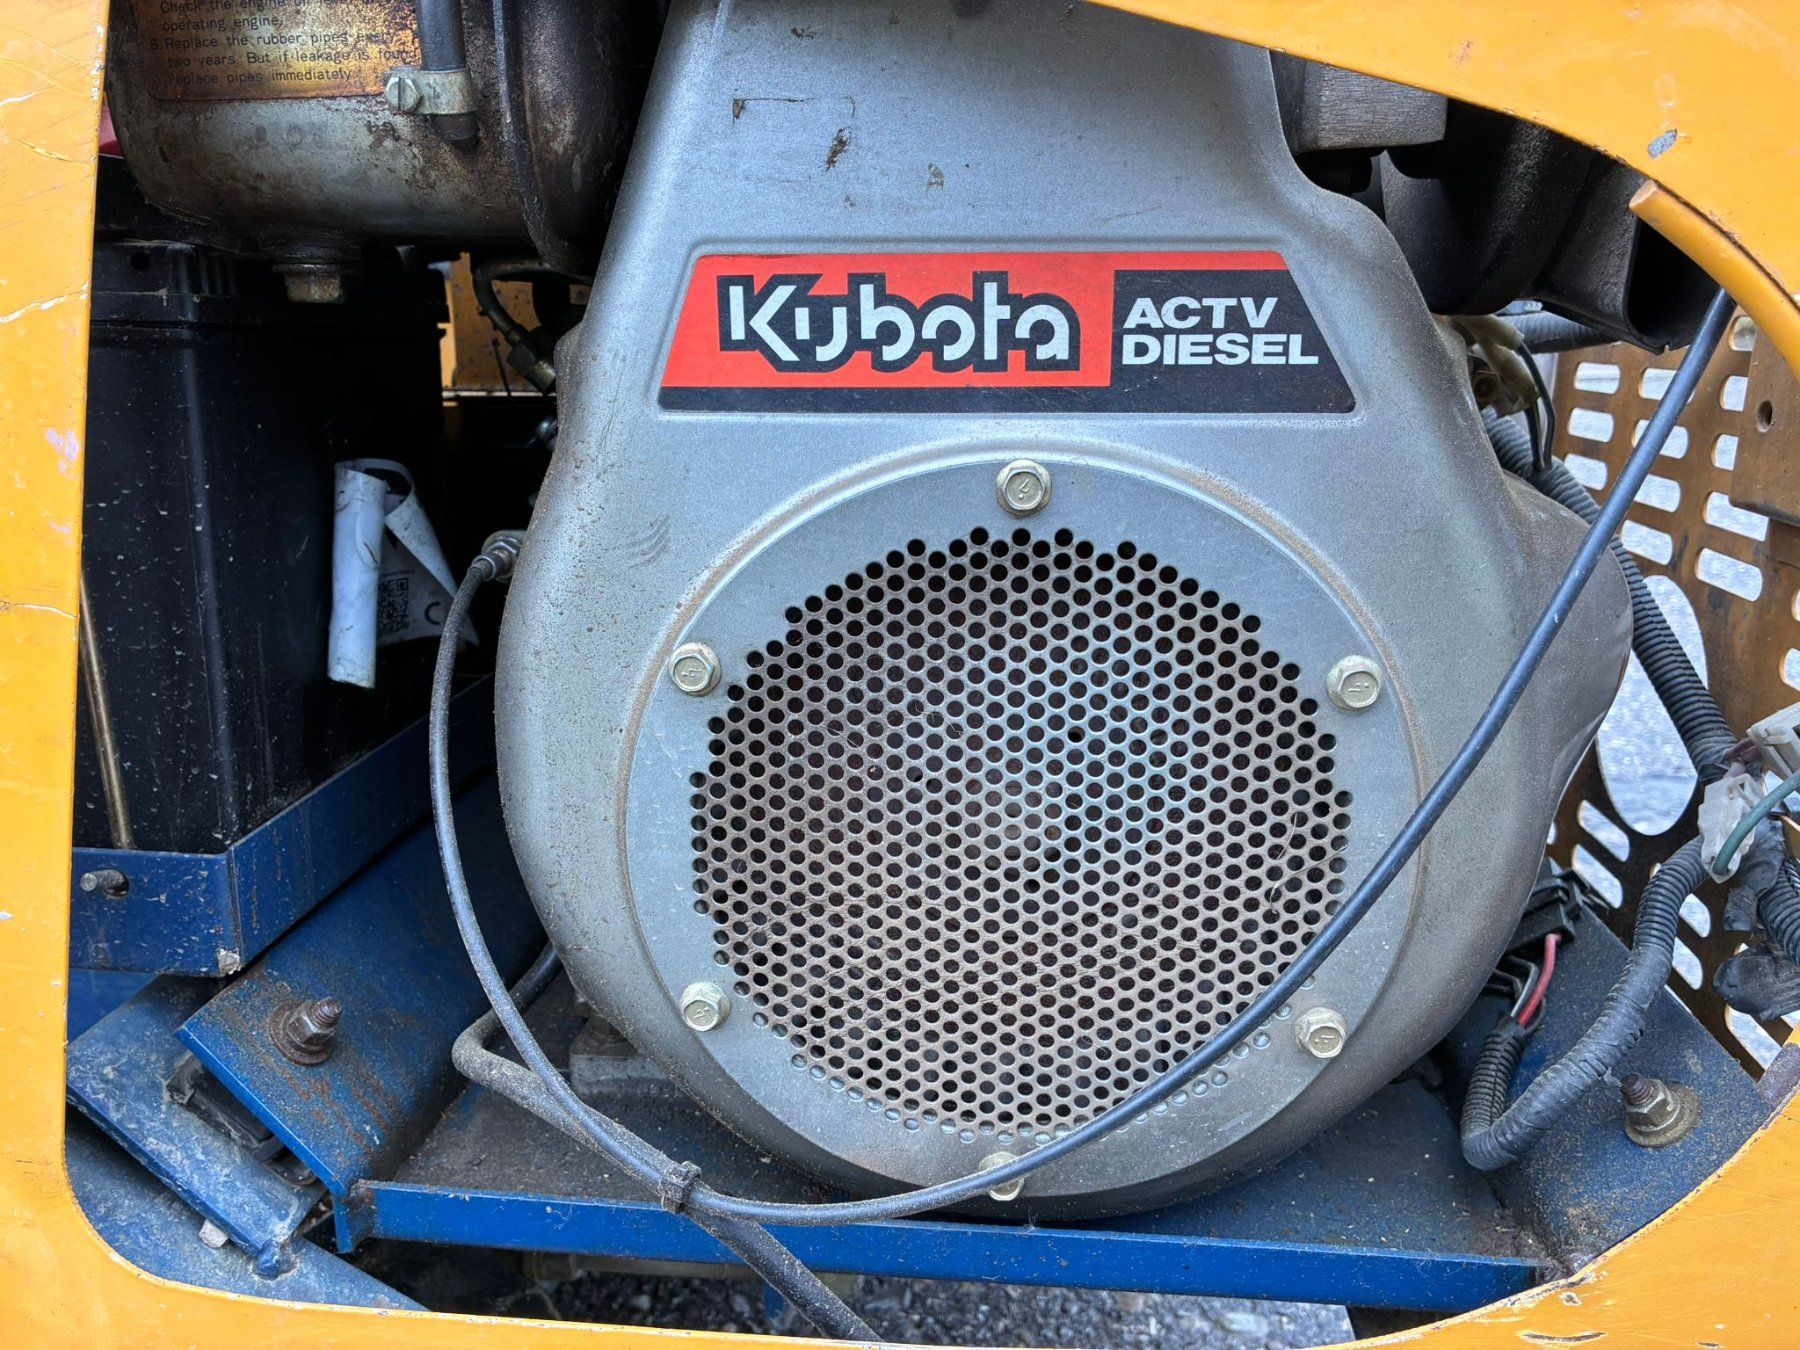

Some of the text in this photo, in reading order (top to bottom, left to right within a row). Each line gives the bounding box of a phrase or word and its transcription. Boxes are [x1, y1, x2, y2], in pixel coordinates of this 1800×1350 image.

[210, 0, 233, 10] the
[162, 19, 227, 32] operating
[164, 36, 219, 50] Replace
[226, 34, 249, 46] the
[256, 33, 302, 46] rubber
[310, 31, 349, 45] pipes
[246, 51, 272, 64] But
[279, 50, 288, 62] if
[296, 47, 350, 64] leakage
[357, 49, 370, 60] is
[227, 71, 263, 83] pipes
[728, 281, 1070, 362] Kubota
[1122, 296, 1278, 329] ACTV
[1121, 332, 1319, 366] DIESEL
